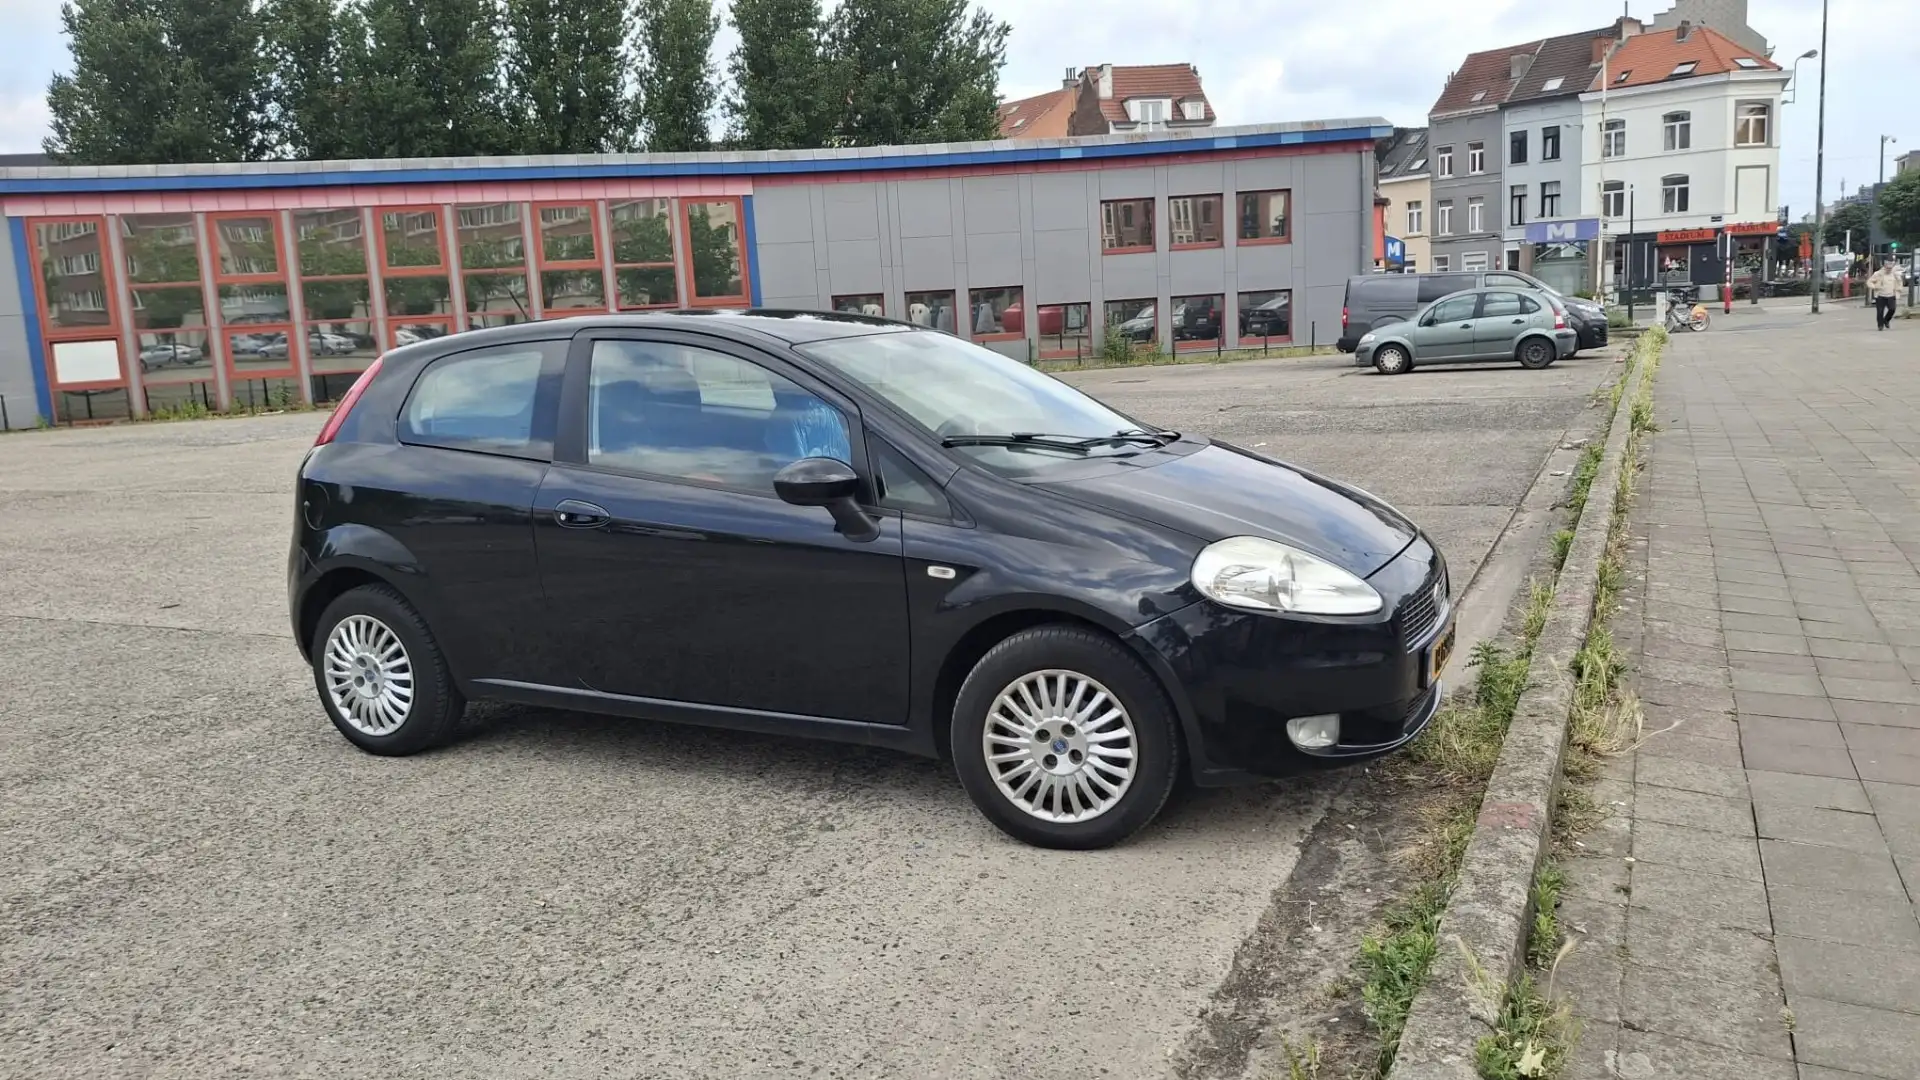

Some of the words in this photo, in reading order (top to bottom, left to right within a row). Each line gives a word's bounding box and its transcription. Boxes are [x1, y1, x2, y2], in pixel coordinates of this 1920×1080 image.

[1547, 223, 1576, 240] M
[1665, 232, 1705, 241] STADIUM
[1388, 241, 1400, 258] M
